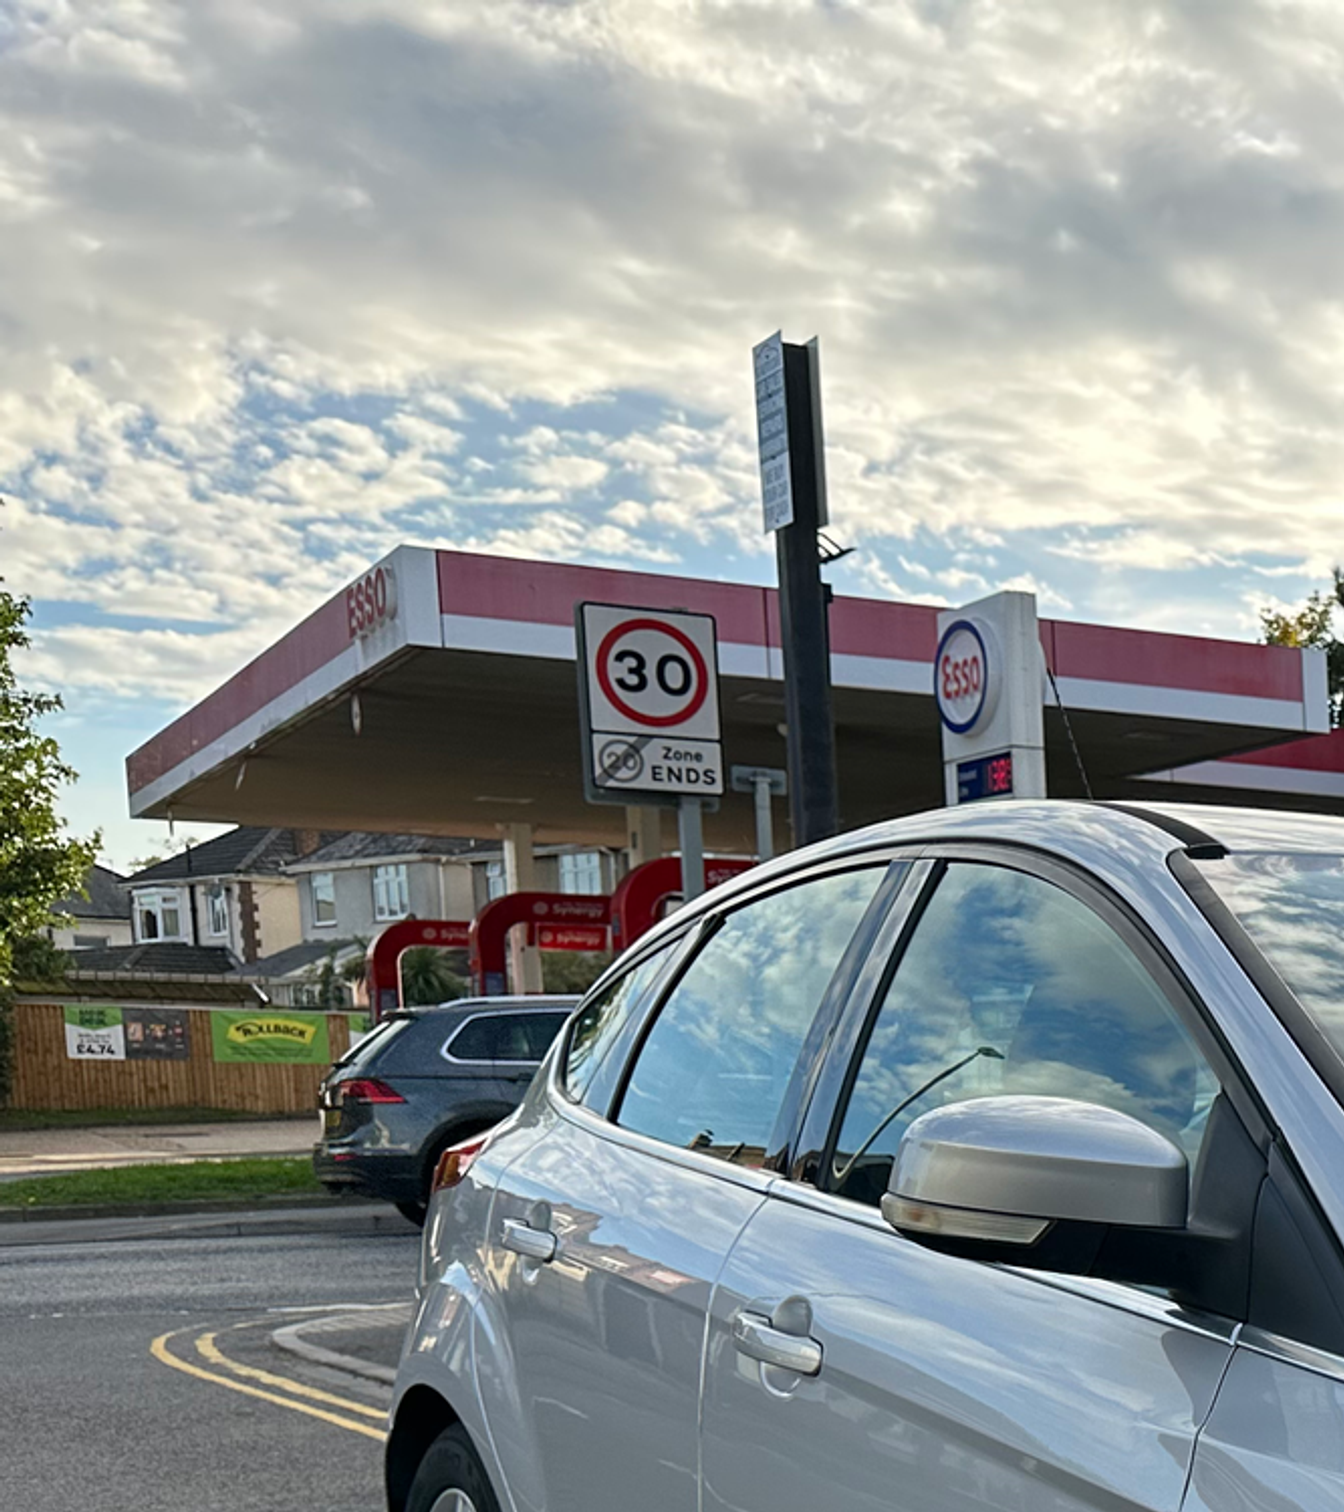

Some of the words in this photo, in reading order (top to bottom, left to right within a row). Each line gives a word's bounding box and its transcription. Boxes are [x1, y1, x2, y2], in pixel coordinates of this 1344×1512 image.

[614, 650, 692, 696] 30
[662, 746, 703, 763] Zone
[651, 765, 717, 785] ENDS
